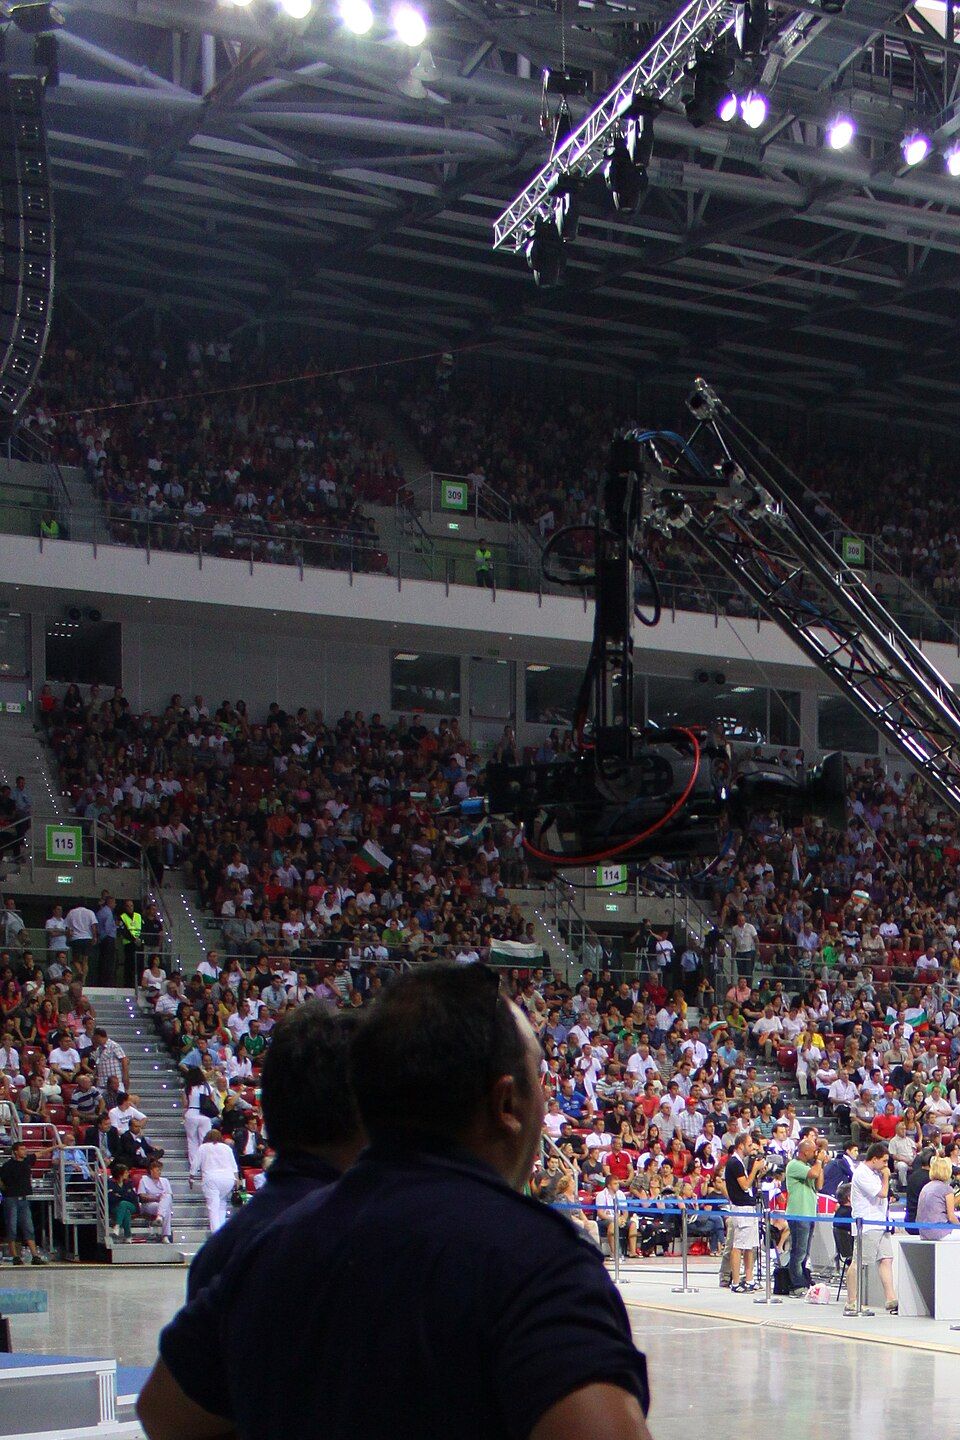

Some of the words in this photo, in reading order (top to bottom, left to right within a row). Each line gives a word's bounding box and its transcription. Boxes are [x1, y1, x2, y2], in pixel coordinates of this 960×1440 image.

[448, 490, 462, 500] 309
[55, 838, 74, 849] 115
[604, 870, 620, 880] 114
